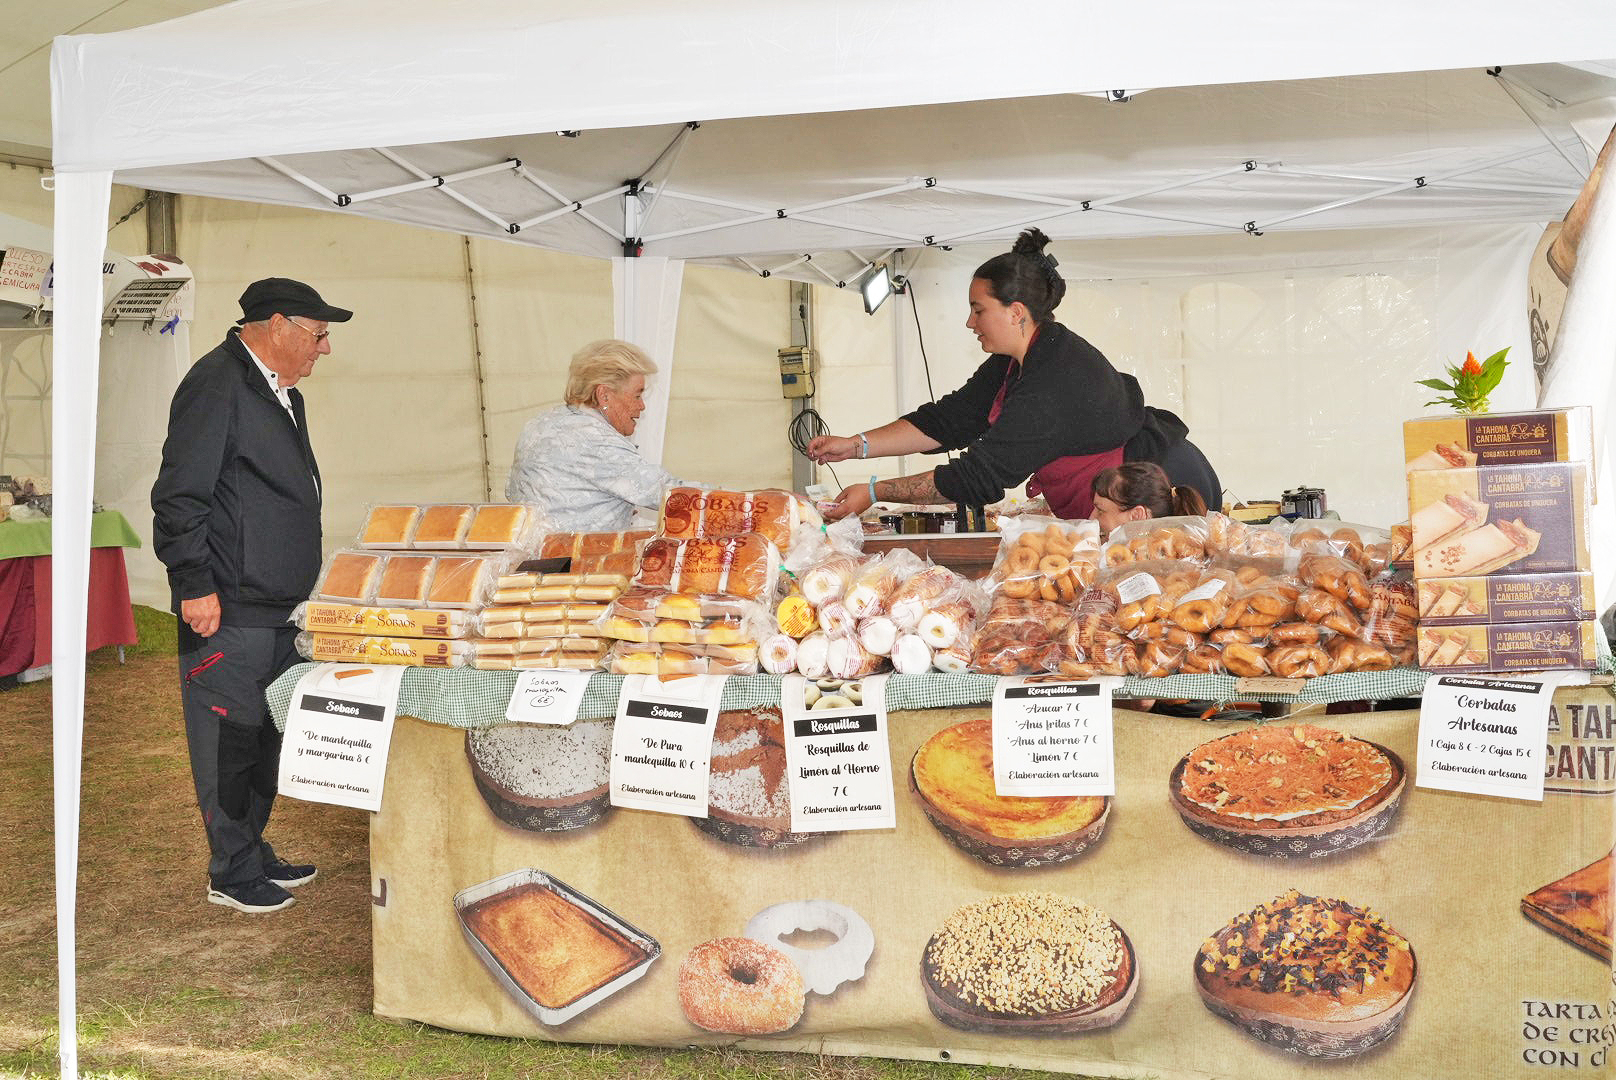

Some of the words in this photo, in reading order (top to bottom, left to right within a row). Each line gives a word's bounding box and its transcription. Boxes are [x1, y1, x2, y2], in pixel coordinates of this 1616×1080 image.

[1482, 424, 1508, 434] TAHONA
[1476, 434, 1511, 443] CANTABRA
[1494, 474, 1523, 483] TAHONA
[1488, 483, 1525, 493] CANTABRA
[1504, 583, 1532, 592] TAHONA
[1496, 591, 1534, 602] CANTABRA
[1504, 632, 1532, 641] TAHONA
[1497, 641, 1534, 651] CANTABRA
[326, 701, 360, 715] Sobaos
[1458, 695, 1517, 712] Corbatas
[650, 706, 683, 719] Sobaos
[811, 718, 860, 733] Rosquillas
[1045, 719, 1071, 730] fritas
[1074, 719, 1080, 728] 7
[1448, 716, 1518, 735] Artesanas
[321, 735, 372, 749] mantequilla
[660, 739, 682, 751] Pura
[1038, 736, 1047, 745] al
[1050, 735, 1080, 745] horno
[1084, 735, 1089, 744] 7
[858, 741, 870, 751] de
[1430, 739, 1434, 748] 1
[1436, 740, 1456, 751] Caja
[1458, 741, 1464, 750] 8
[1480, 744, 1487, 753] 2
[1489, 744, 1512, 758] Cajas
[1516, 748, 1524, 757] 15
[297, 747, 304, 756] y
[306, 749, 354, 762] margarina
[356, 754, 362, 762] 8
[1063, 752, 1069, 760] 7
[624, 754, 677, 769] mantequilla
[679, 759, 687, 769] 10
[831, 764, 841, 774] al
[843, 763, 880, 774] Horno
[1062, 770, 1099, 778] artesana
[1488, 766, 1527, 780] artesana
[337, 783, 370, 793] artesana
[833, 786, 839, 796] 7
[665, 790, 696, 800] artesana
[849, 803, 882, 812] artesana
[1522, 1001, 1602, 1020] TARTA
[1523, 1021, 1558, 1041] DE
[1523, 1049, 1578, 1067] CON
